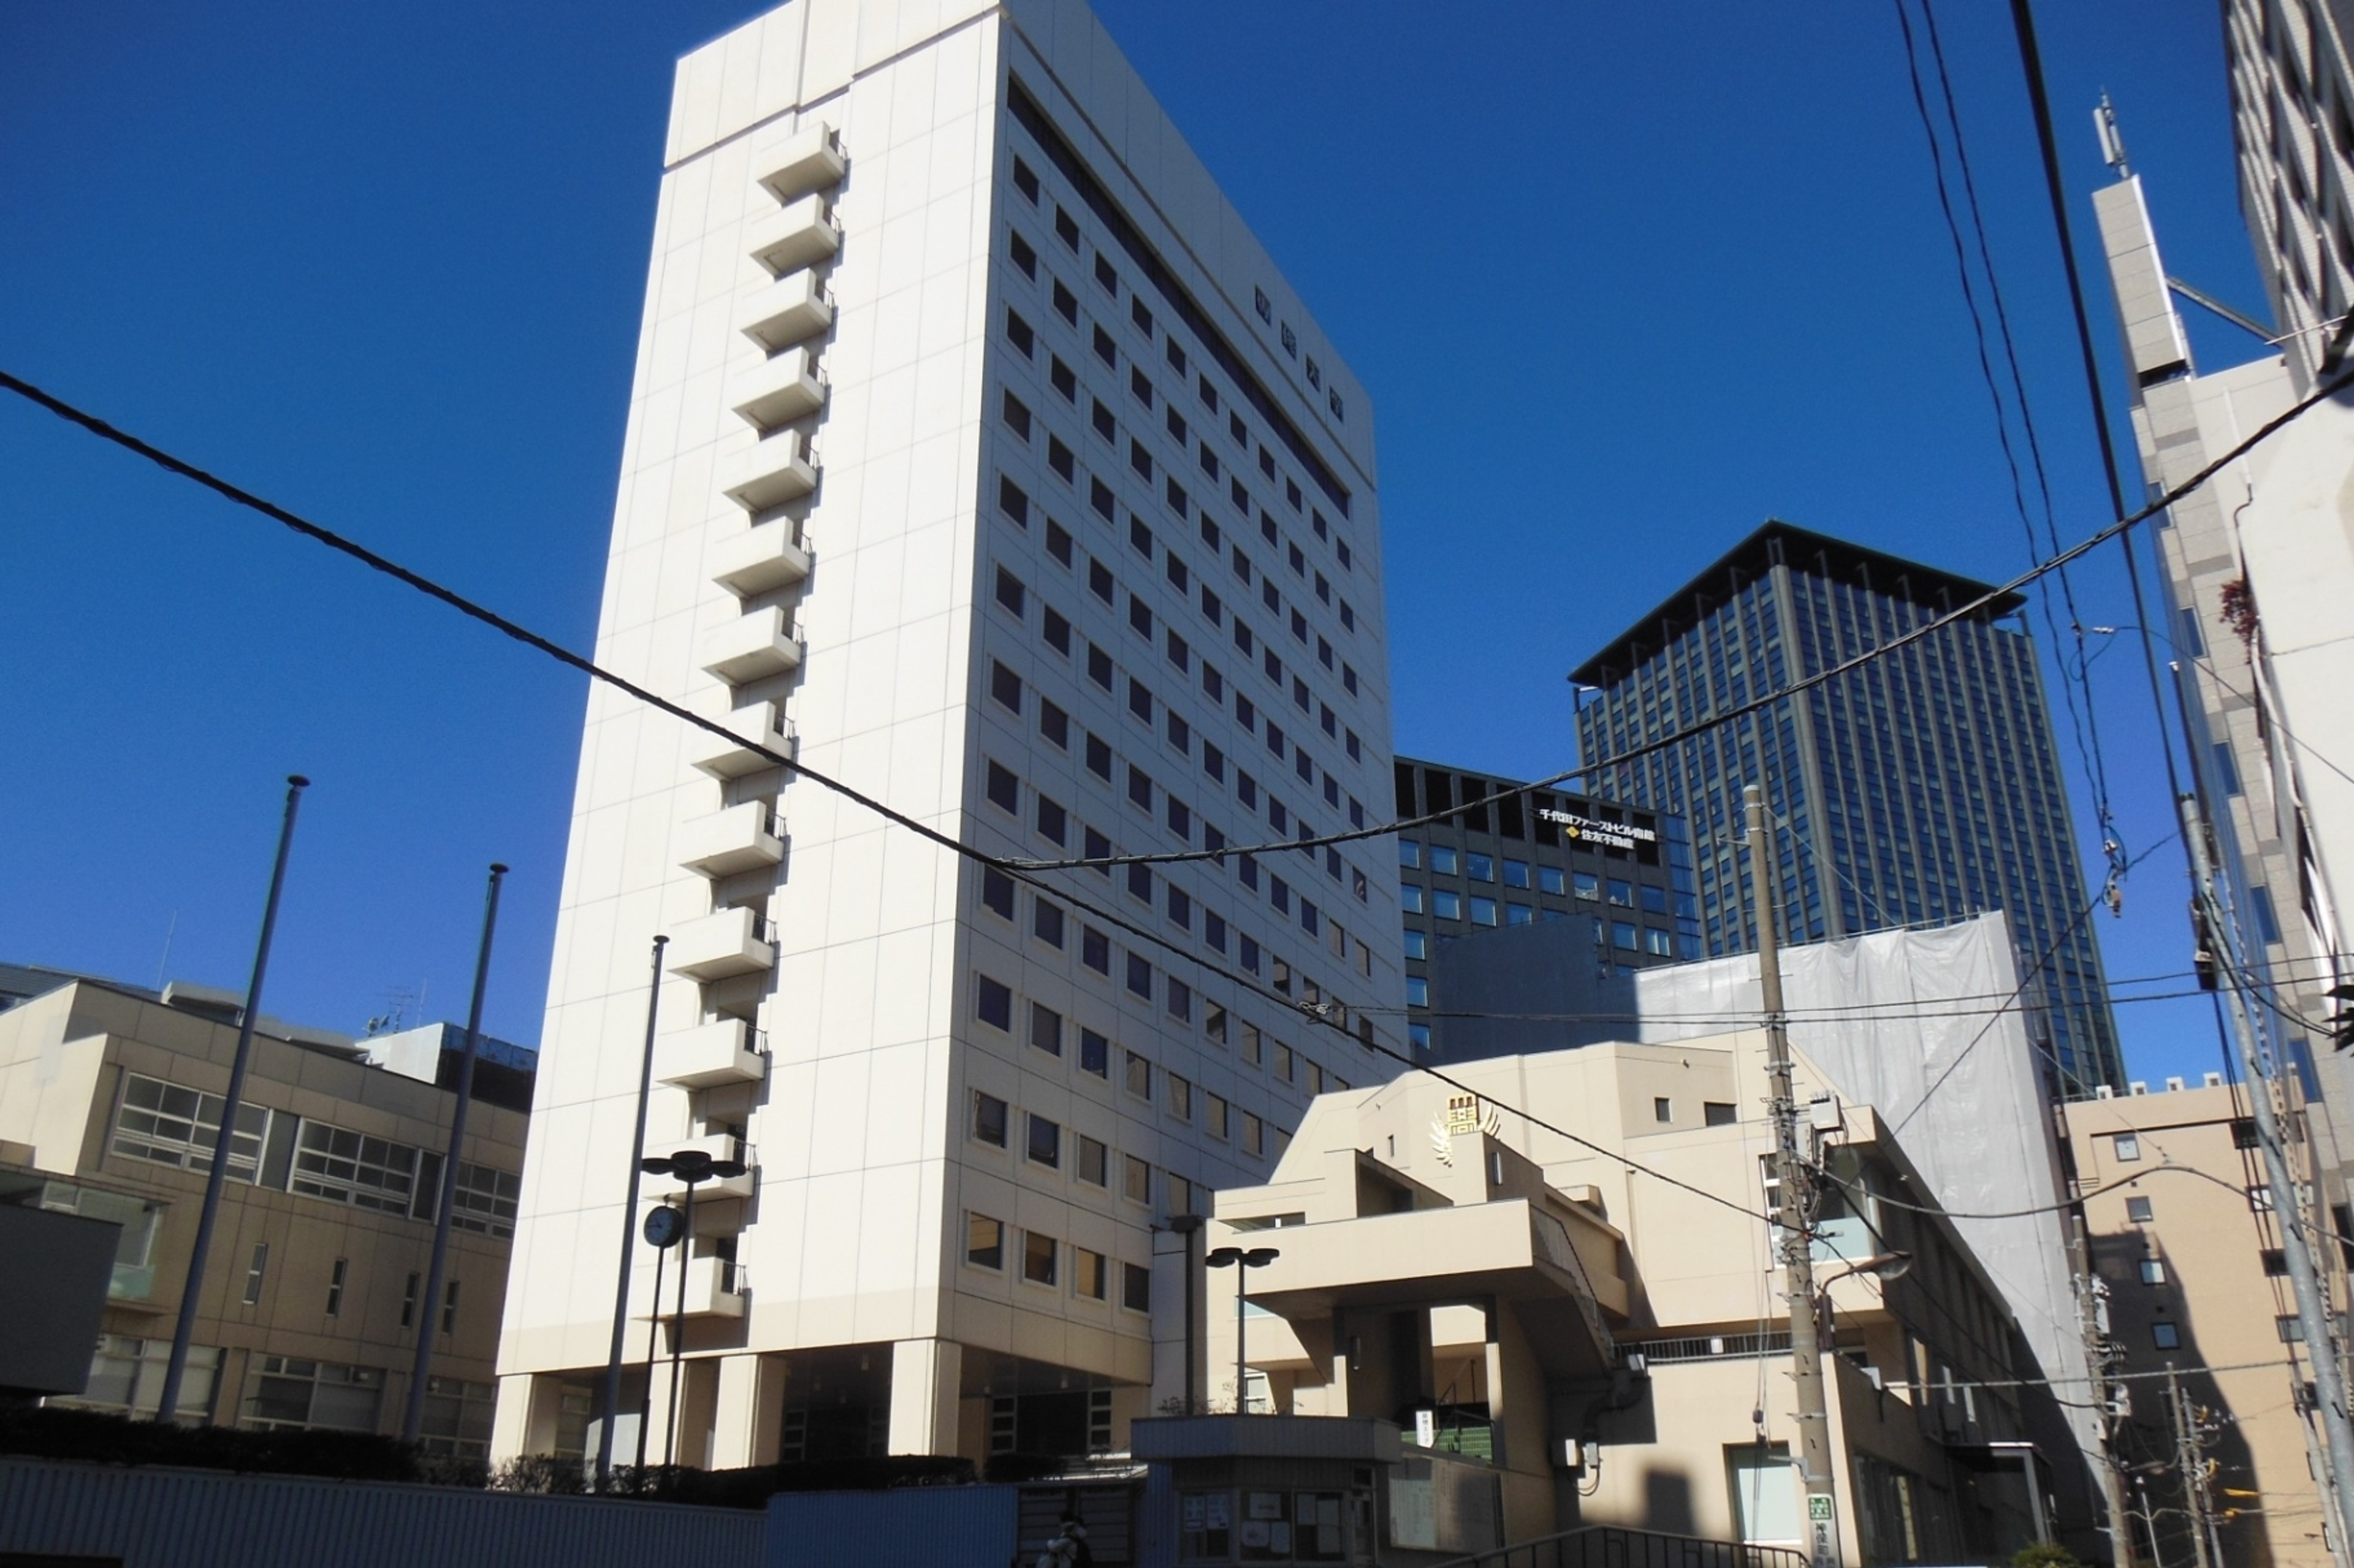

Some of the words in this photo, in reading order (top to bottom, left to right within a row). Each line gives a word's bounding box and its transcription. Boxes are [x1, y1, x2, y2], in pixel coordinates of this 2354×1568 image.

[1580, 828, 1635, 850] 住友不動産
